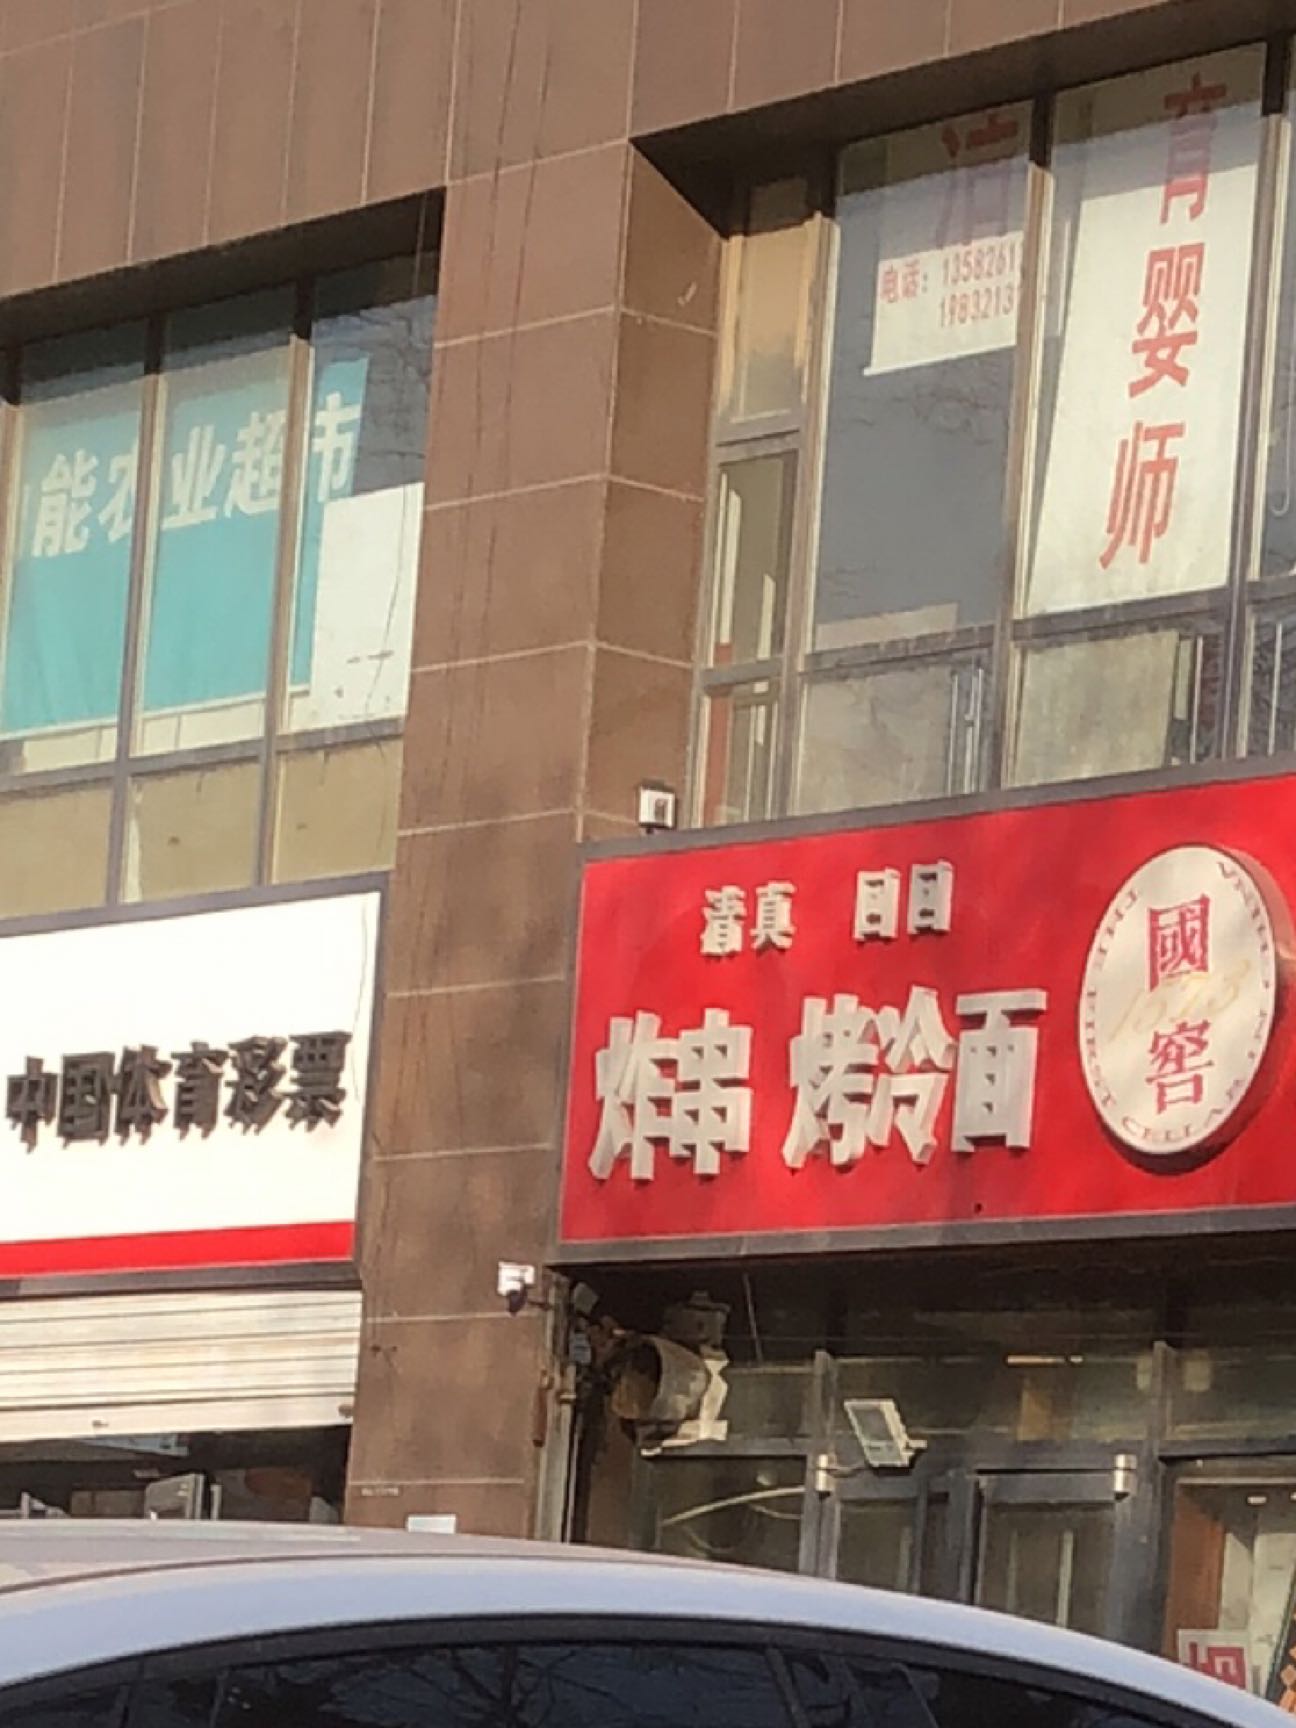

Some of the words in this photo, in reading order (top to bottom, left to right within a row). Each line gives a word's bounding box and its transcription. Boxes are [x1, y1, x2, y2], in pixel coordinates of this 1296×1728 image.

[1100, 73, 1227, 570] 育婴师
[18, 391, 363, 560] 能农业超市
[701, 880, 797, 956] 清真
[5, 1030, 352, 1151] 中国体育彩票
[589, 1009, 754, 1181] 炸串
[783, 986, 1048, 1168] 烤冷面
